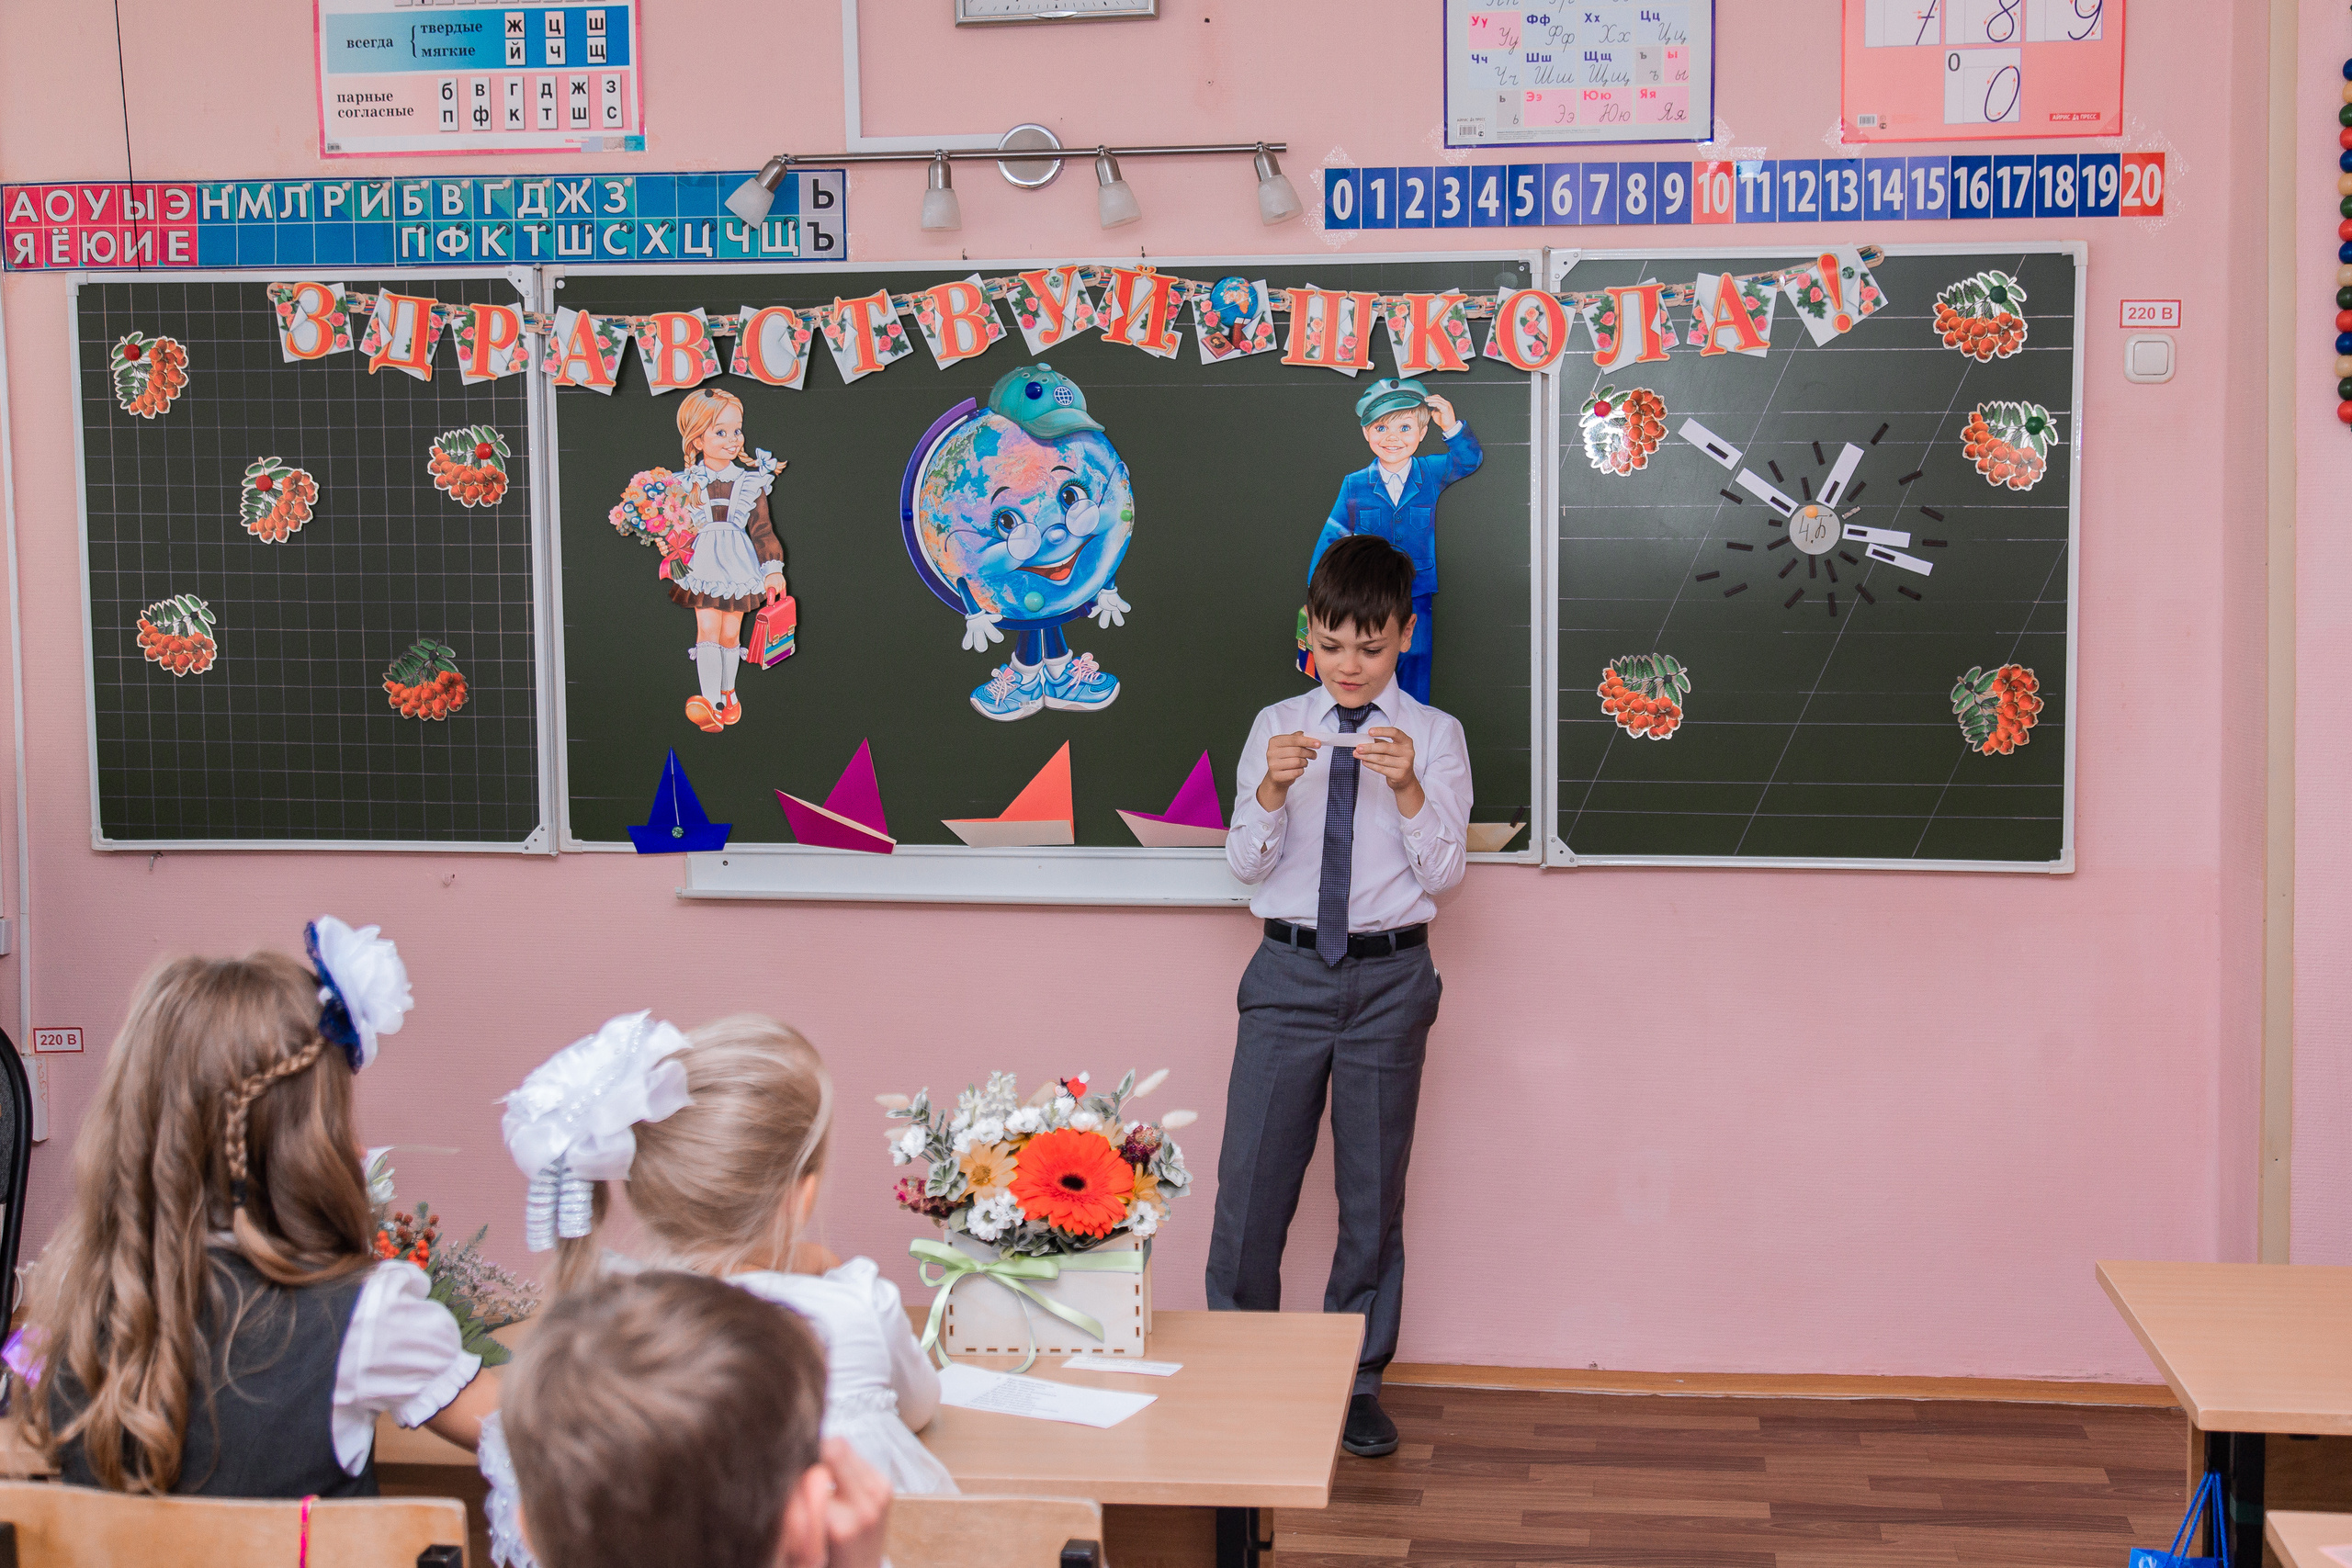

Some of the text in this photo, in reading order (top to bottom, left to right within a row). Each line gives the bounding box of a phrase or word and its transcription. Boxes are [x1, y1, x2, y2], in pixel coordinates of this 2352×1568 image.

[421, 22, 483, 35] твердые
[346, 38, 394, 50] всегда
[421, 45, 476, 58] мягкие
[1948, 52, 1961, 72] 0
[336, 92, 394, 106] парные
[337, 106, 414, 118] согласные
[1333, 164, 2162, 220] 0 1 2 3 4 5 6 7 8 9 10 11 12 13 14 15 16 17 18 19 20
[2129, 307, 2156, 320] 220
[40, 1034, 62, 1045] 220
